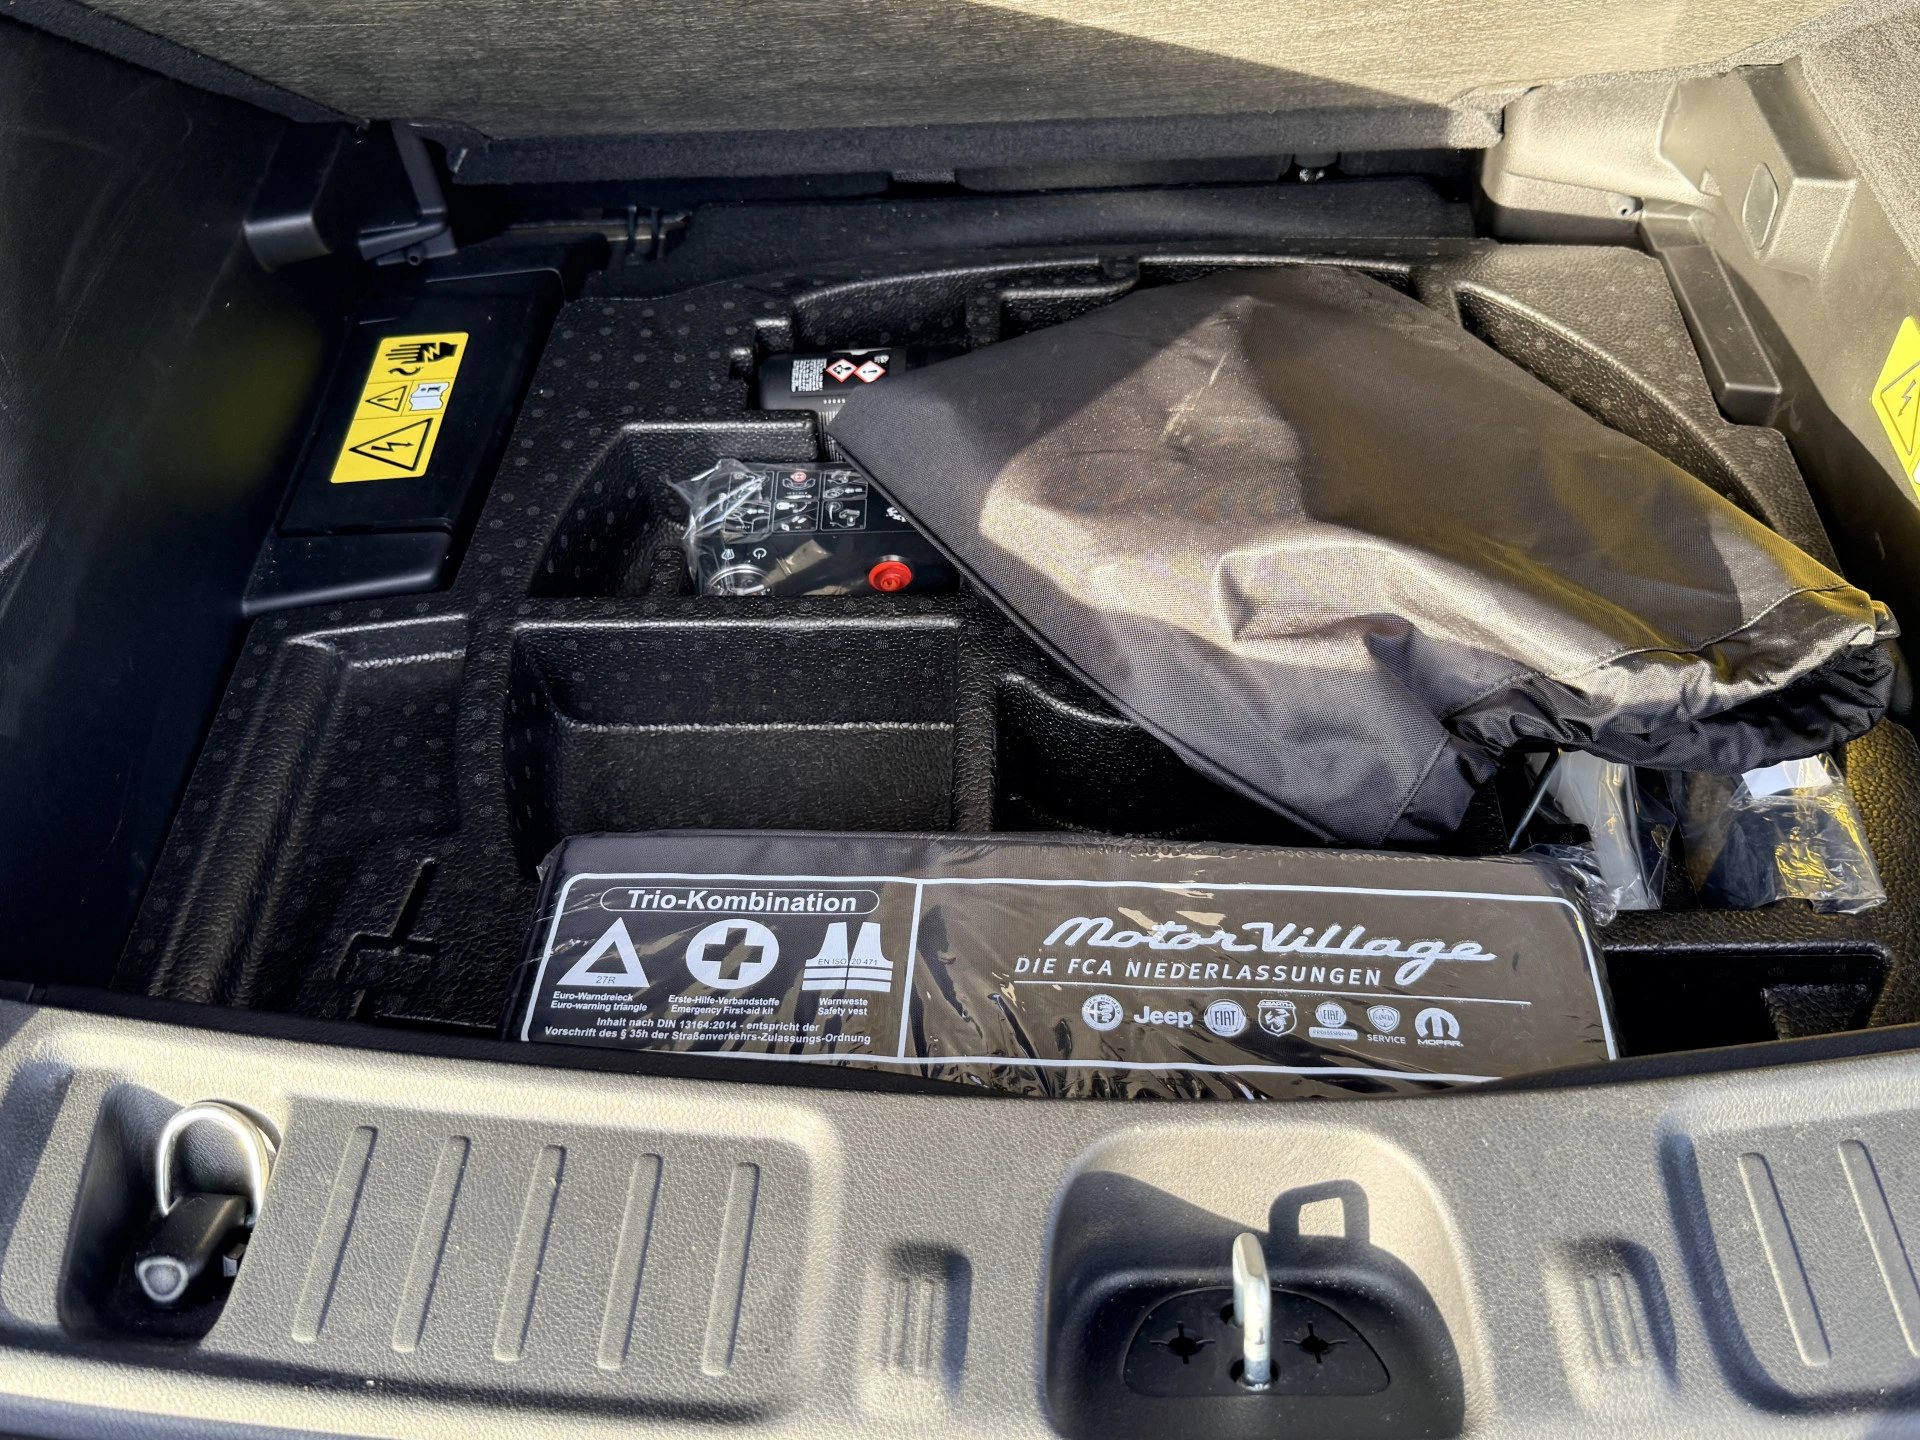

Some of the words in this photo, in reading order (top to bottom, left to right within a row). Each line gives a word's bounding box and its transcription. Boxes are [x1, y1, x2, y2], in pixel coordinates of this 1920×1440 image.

[627, 888, 857, 912] Trio-Kombination
[817, 958, 830, 966] EN
[1014, 957, 1056, 975] DIE
[1067, 959, 1112, 976] FCA
[1125, 961, 1381, 986] NIEDERLASSUNGEN
[596, 975, 615, 984] 27R
[553, 991, 634, 1002] Euro-Warndreieck
[668, 994, 780, 1007] Erste-Hilfe-Verbandstoffe
[819, 997, 868, 1006] Warnweste
[550, 1000, 611, 1012] Euro-warning
[613, 1002, 648, 1012] triangle
[671, 1005, 721, 1016] Emergency
[722, 1006, 760, 1016] First-aid
[762, 1007, 774, 1016] kit
[818, 1007, 846, 1016] Safety
[1214, 1010, 1238, 1026] FIAT
[1323, 1008, 1340, 1021] FIAT
[596, 1017, 627, 1028] Inhalt
[628, 1019, 655, 1028] nach
[657, 1019, 677, 1029] DIN
[679, 1020, 738, 1031] 13164:2014
[746, 1022, 800, 1034] entspricht
[802, 1024, 821, 1033] der
[545, 1026, 596, 1037] Vorschrift
[598, 1029, 619, 1039] des
[620, 1030, 627, 1040] §
[629, 1030, 649, 1039] 35h
[651, 1031, 670, 1040] der
[671, 1031, 872, 1045] Straßenverkehrs-Zulassungs-Ordnung
[1367, 1034, 1406, 1045] SERVICE
